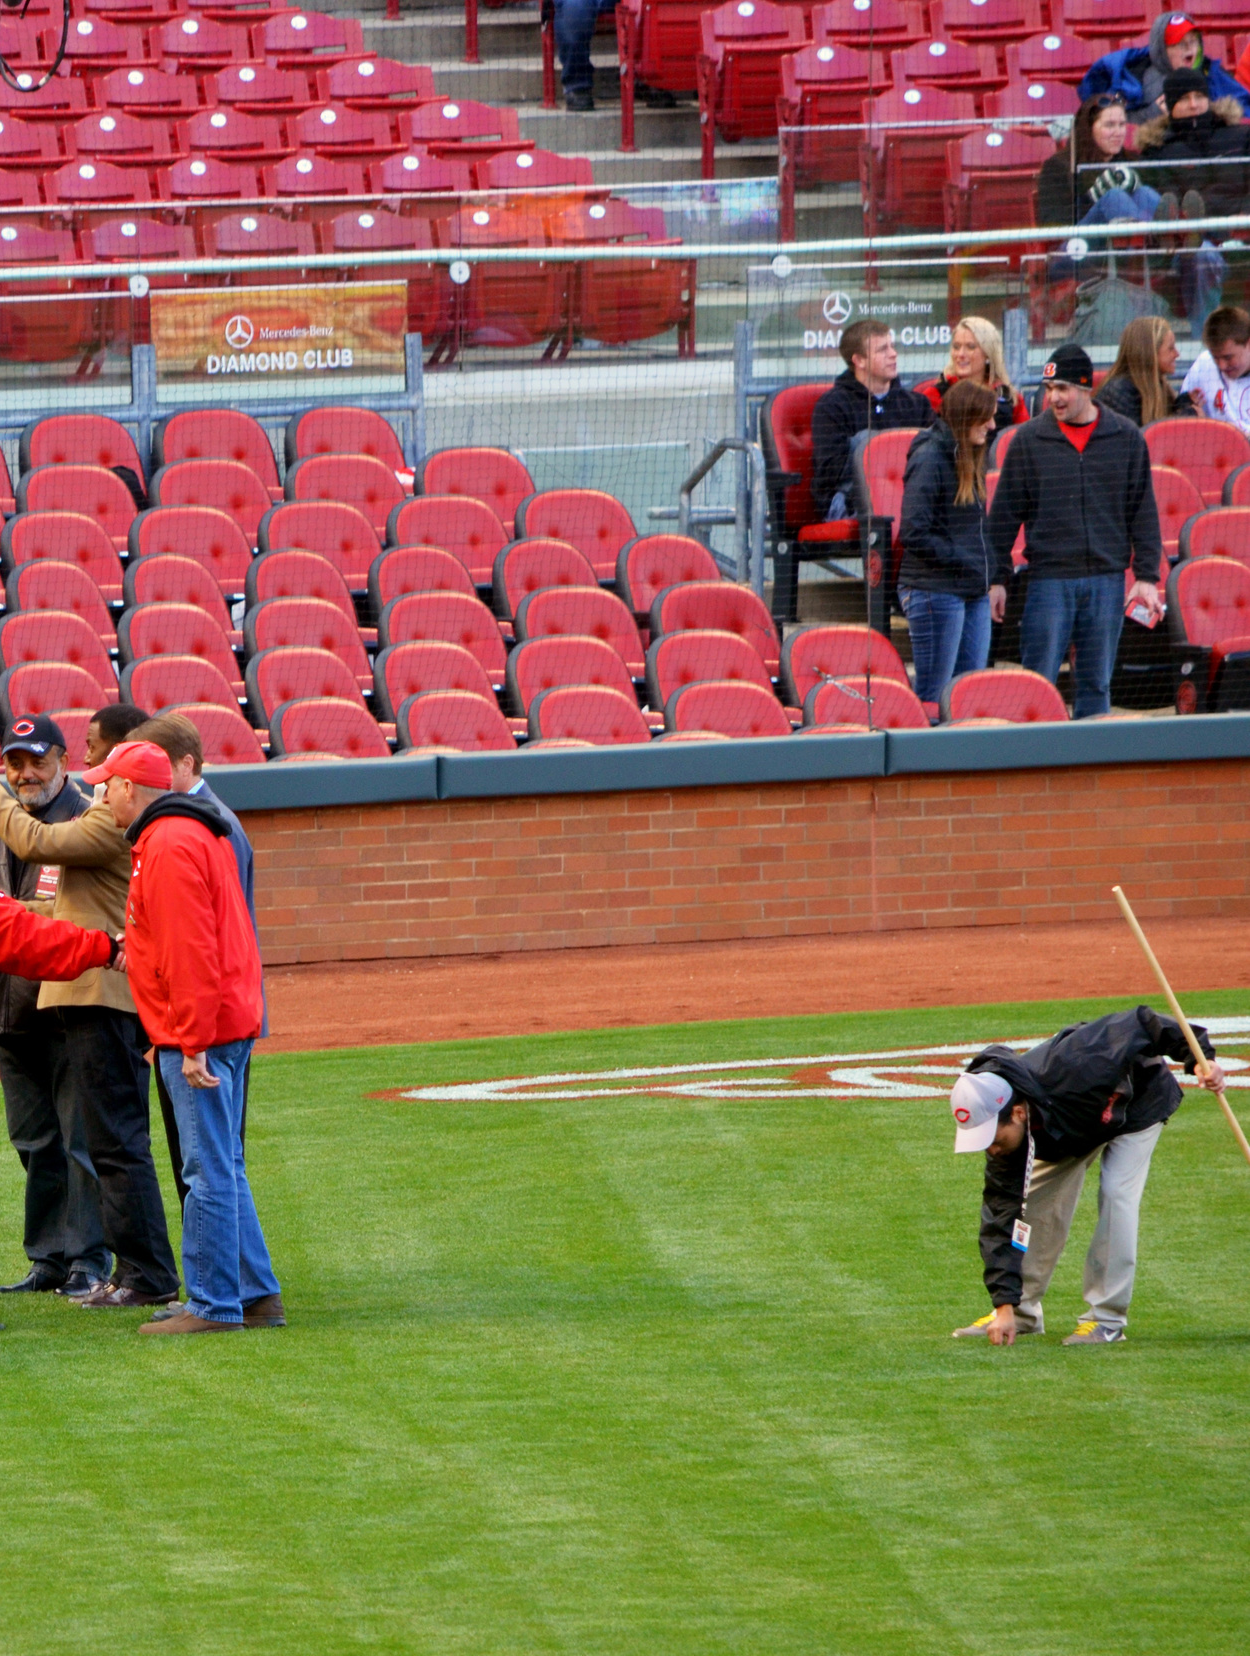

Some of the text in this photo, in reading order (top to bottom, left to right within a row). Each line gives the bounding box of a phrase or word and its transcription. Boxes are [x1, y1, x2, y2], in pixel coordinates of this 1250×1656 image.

[858, 301, 933, 315] Mercedes-Benz
[259, 325, 334, 340] Mercedes-Benz
[901, 325, 952, 346] CLUB
[207, 348, 354, 374] DIAMOND CLUB
